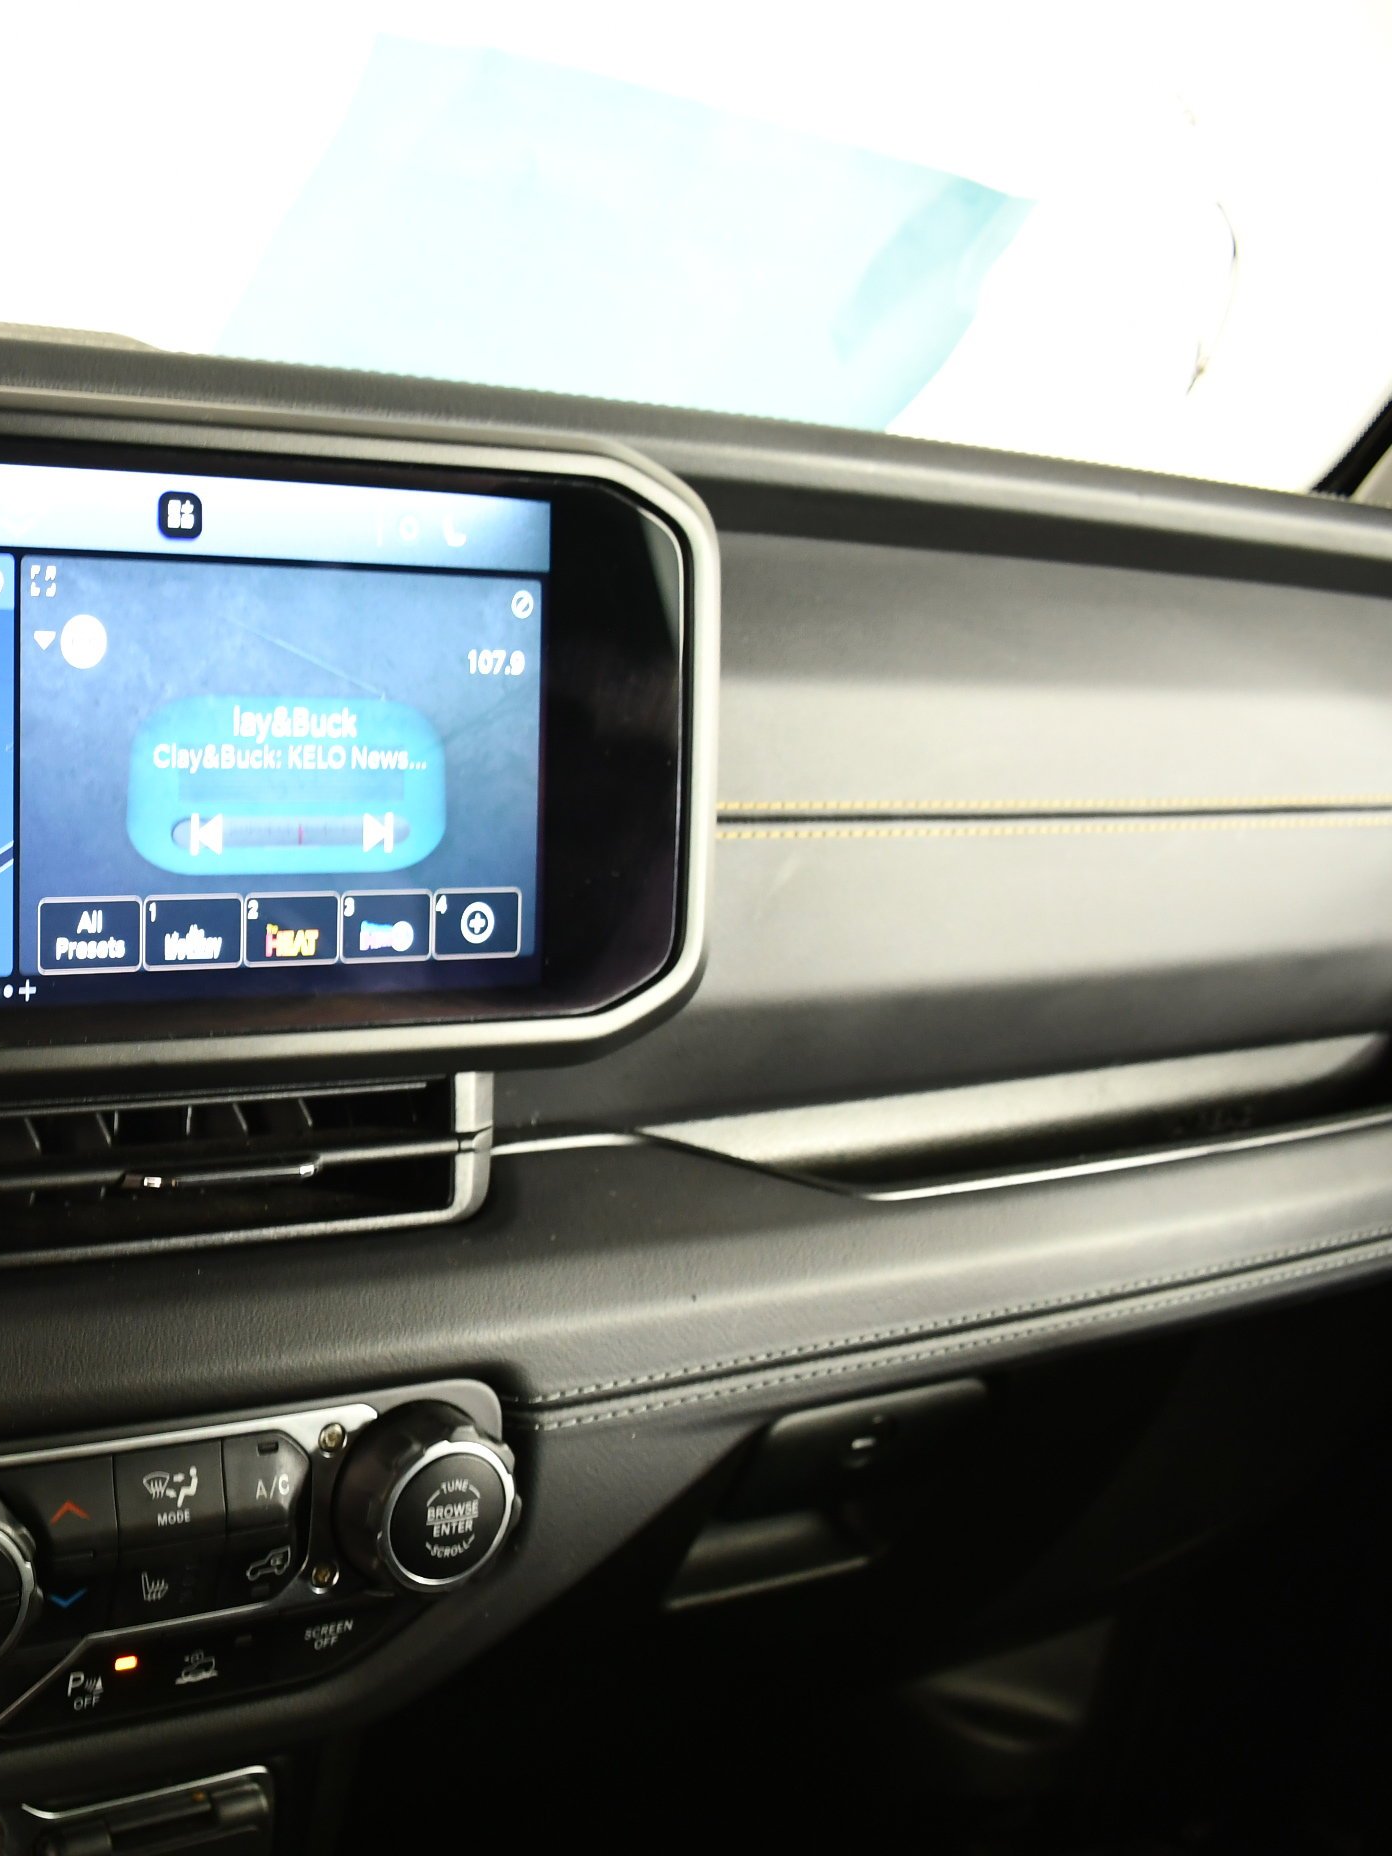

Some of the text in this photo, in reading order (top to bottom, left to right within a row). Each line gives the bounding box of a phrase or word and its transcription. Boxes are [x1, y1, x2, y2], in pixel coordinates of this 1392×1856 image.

[467, 649, 525, 675] 107.9
[153, 743, 283, 774] Clay&Buck:
[287, 744, 346, 769] KELO
[149, 902, 156, 922] 1
[247, 900, 258, 919] 2
[344, 897, 355, 917] 3
[436, 895, 447, 914] 4
[76, 910, 103, 934] All
[56, 937, 125, 960] Presets
[256, 1473, 290, 1500] A/C
[440, 1479, 469, 1495] TUNE
[157, 1508, 190, 1527] MODE
[427, 1499, 479, 1521] BROWSE
[433, 1519, 473, 1538] ENTER
[304, 1618, 354, 1641] SCREEN
[314, 1633, 338, 1650] OFF
[73, 1694, 101, 1711] OFF
